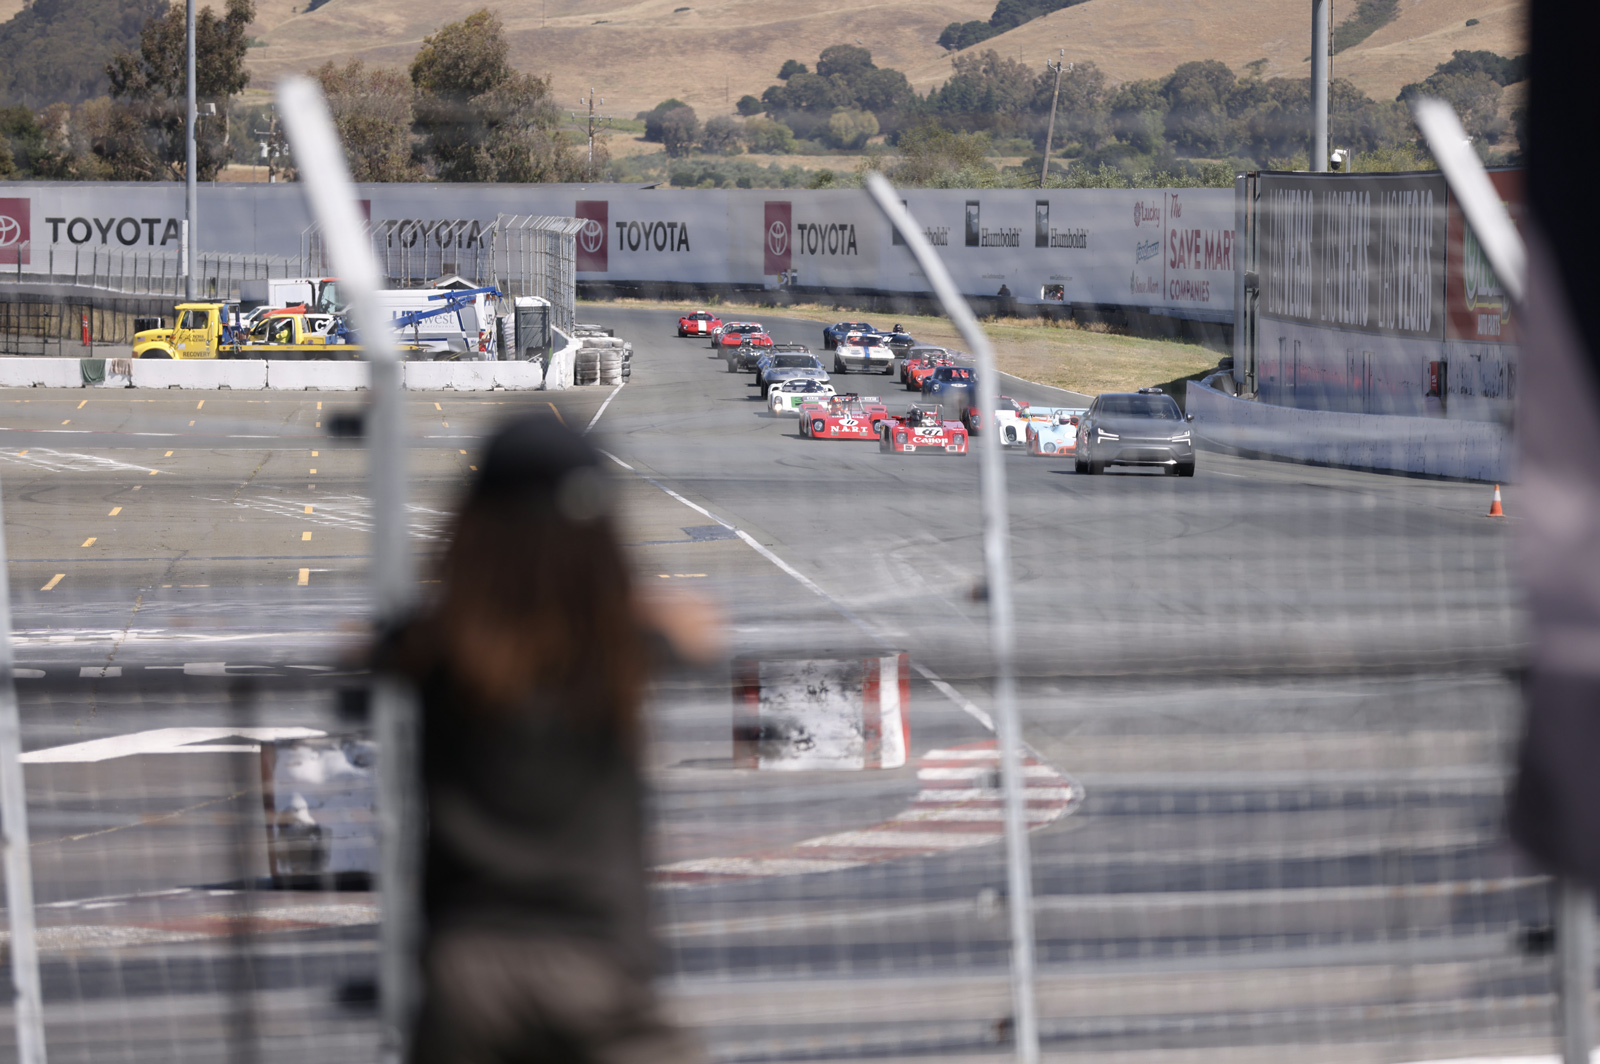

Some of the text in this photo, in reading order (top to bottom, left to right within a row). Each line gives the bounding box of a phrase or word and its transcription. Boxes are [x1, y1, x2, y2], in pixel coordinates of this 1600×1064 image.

[1141, 200, 1160, 228] Lucky
[1170, 193, 1182, 218] The
[45, 217, 178, 246] TOYOTA
[382, 219, 484, 249] TOYOTA
[616, 221, 690, 252] TOYOTA
[797, 223, 858, 255] TOYOTA
[981, 227, 1020, 248] Humboldt
[1050, 227, 1087, 249] Humboldt
[1170, 228, 1235, 272] SAVE MART
[1169, 279, 1210, 302] COMPANIES
[1488, 314, 1500, 336] PARTS
[912, 437, 949, 447] Canon
